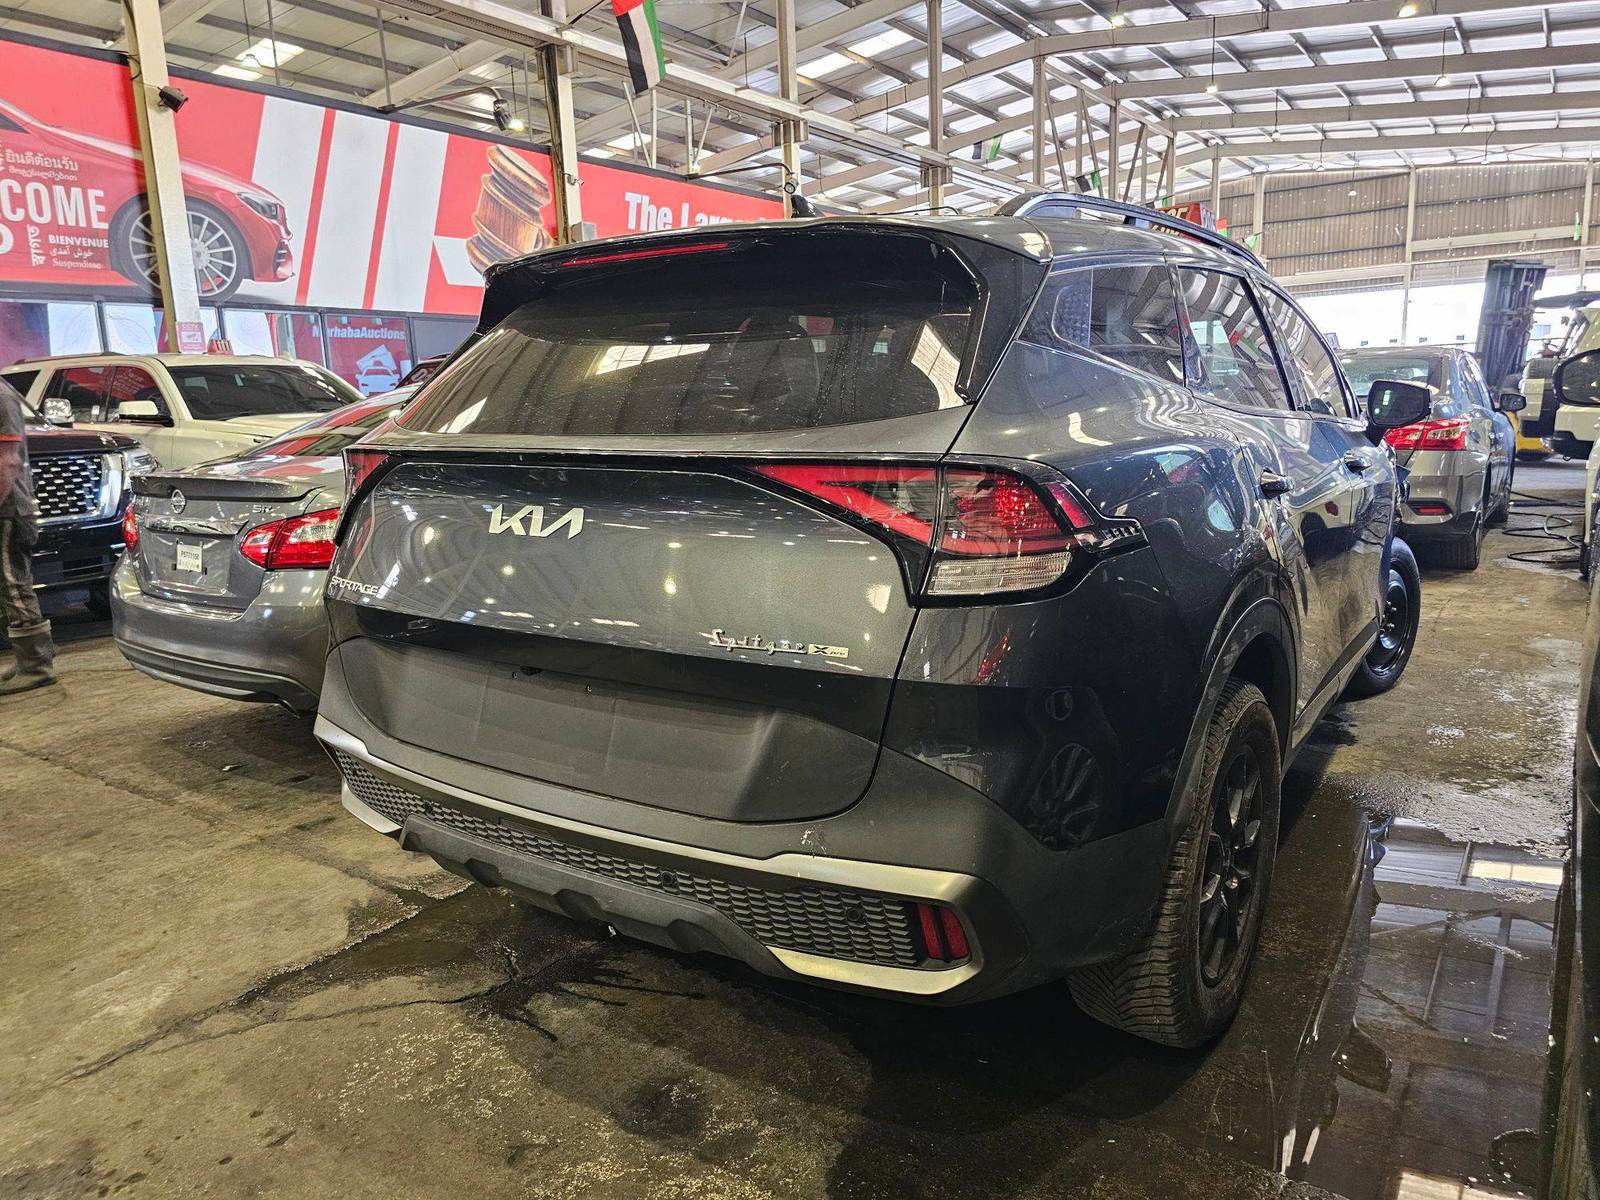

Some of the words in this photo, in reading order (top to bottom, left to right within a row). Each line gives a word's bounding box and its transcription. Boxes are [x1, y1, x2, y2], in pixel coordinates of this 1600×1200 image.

[0, 178, 109, 230] COME
[625, 191, 673, 231] The
[48, 234, 109, 249] BIENVENUE
[312, 325, 405, 339] MrhabaAuctions
[489, 504, 584, 539] KIA
[331, 575, 379, 596] SPORTAGE
